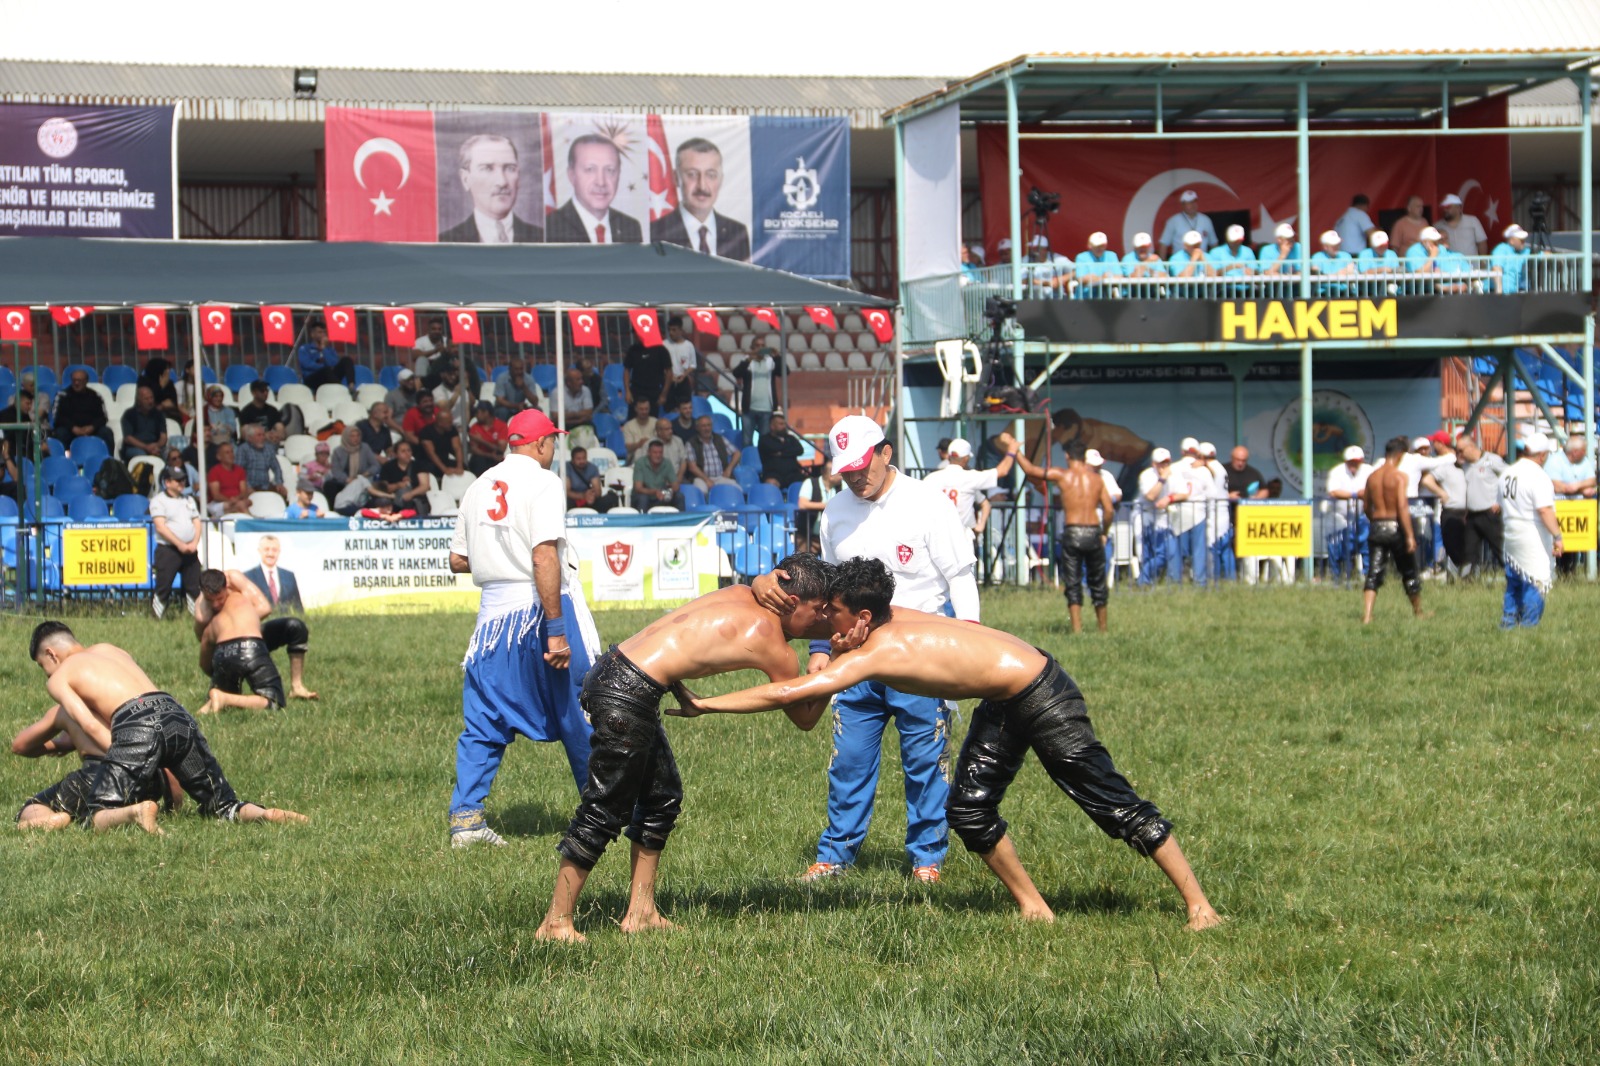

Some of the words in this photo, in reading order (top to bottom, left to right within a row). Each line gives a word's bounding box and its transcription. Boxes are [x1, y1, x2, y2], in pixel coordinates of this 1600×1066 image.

[0, 165, 40, 182] ATILAN
[43, 163, 72, 183] TÜM
[74, 167, 129, 187] SPORCU,
[0, 185, 28, 205] NÖR
[31, 189, 47, 206] VE
[51, 188, 155, 209] HAKEMLERİMİZE
[0, 208, 66, 230] BAŞARILAR
[68, 207, 121, 228] DİLERİM
[1221, 298, 1398, 340] HAKEM
[1503, 475, 1518, 500] 30
[486, 479, 509, 521] 3
[363, 519, 420, 530] KOCAELİ
[422, 516, 456, 529] BÜYÜ
[1247, 522, 1303, 539] HAKEM
[1556, 515, 1589, 534] KEM
[81, 535, 131, 553] SEYİRCİ
[344, 538, 388, 551] KATILAN
[392, 535, 415, 550] TÜM
[418, 537, 452, 550] SPORC
[78, 557, 135, 575] TRİBÜNÜ
[323, 555, 378, 571] ANTRENÖR
[381, 558, 394, 570] VE
[399, 557, 450, 570] HAKEMLE
[353, 575, 410, 590] BAŞARILAR
[413, 573, 457, 588] DİLERİM
